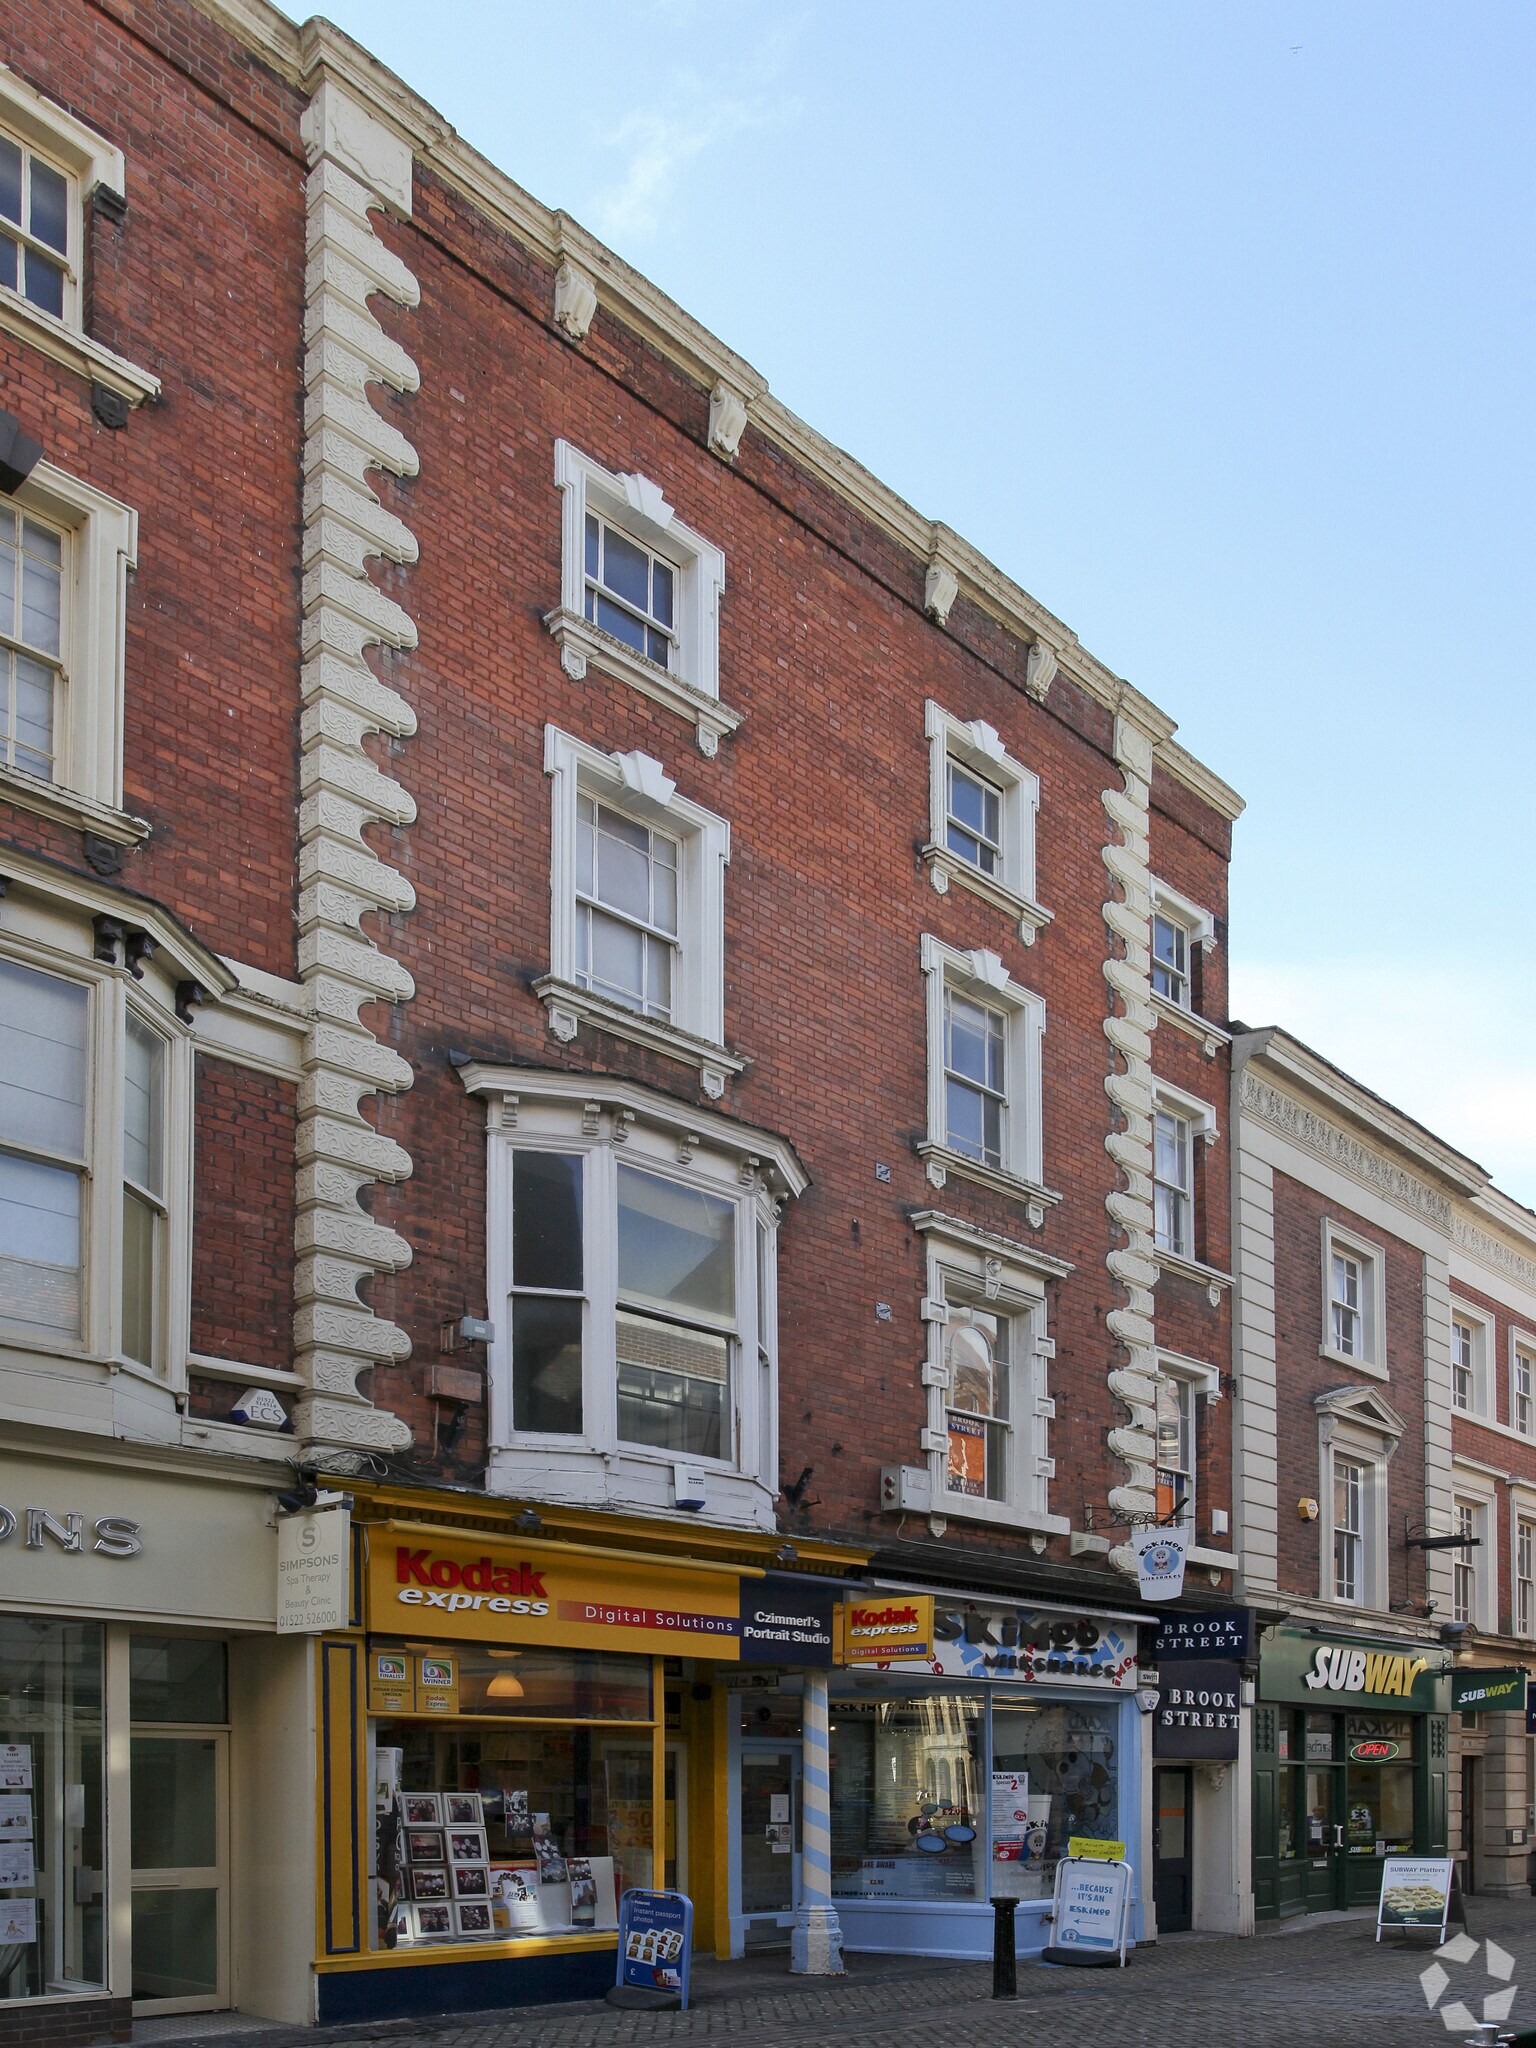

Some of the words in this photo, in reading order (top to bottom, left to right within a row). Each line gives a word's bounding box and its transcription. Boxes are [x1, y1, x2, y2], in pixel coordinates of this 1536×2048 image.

[250, 1405, 282, 1422] ECS
[951, 1415, 981, 1427] BROOK
[951, 1422, 982, 1436] STREET
[301, 1527, 316, 1547] S
[279, 1553, 339, 1572] SIMPSONS
[397, 1546, 548, 1598] Kodak
[286, 1576, 299, 1587] Spa
[300, 1573, 331, 1584] Therapy
[304, 1586, 312, 1595] &
[285, 1599, 309, 1611] Beauty
[310, 1596, 332, 1607] Clinic
[397, 1588, 550, 1617] express
[279, 1614, 304, 1627] 01522
[306, 1610, 337, 1625] 526000
[585, 1605, 647, 1624] Digital
[656, 1612, 734, 1632] Solutions
[851, 1606, 919, 1627] Kodak
[850, 1624, 919, 1637] express
[1164, 1620, 1236, 1636] BROOK
[743, 1626, 790, 1642] Portrait
[791, 1630, 831, 1645] Studio
[1155, 1635, 1243, 1649] STREET
[851, 1646, 878, 1656] Digital
[881, 1646, 919, 1654] Solutions
[1305, 1646, 1428, 1697] SUBWAY
[1168, 1688, 1236, 1708] BROOK
[1458, 1681, 1518, 1704] SUBWAY
[1161, 1709, 1240, 1729] STREET
[1357, 1743, 1390, 1756] OPEN
[1011, 1779, 1018, 1790] 2
[1350, 1808, 1371, 1820] £3
[1348, 1845, 1376, 1854] SUBWAY
[1384, 1844, 1411, 1853] SUBWAY
[1077, 1893, 1093, 1901] IT'S
[1093, 1895, 1105, 1903] AN
[633, 1907, 655, 1916] Instant
[655, 1911, 682, 1920] passport
[633, 1916, 654, 1924] photos
